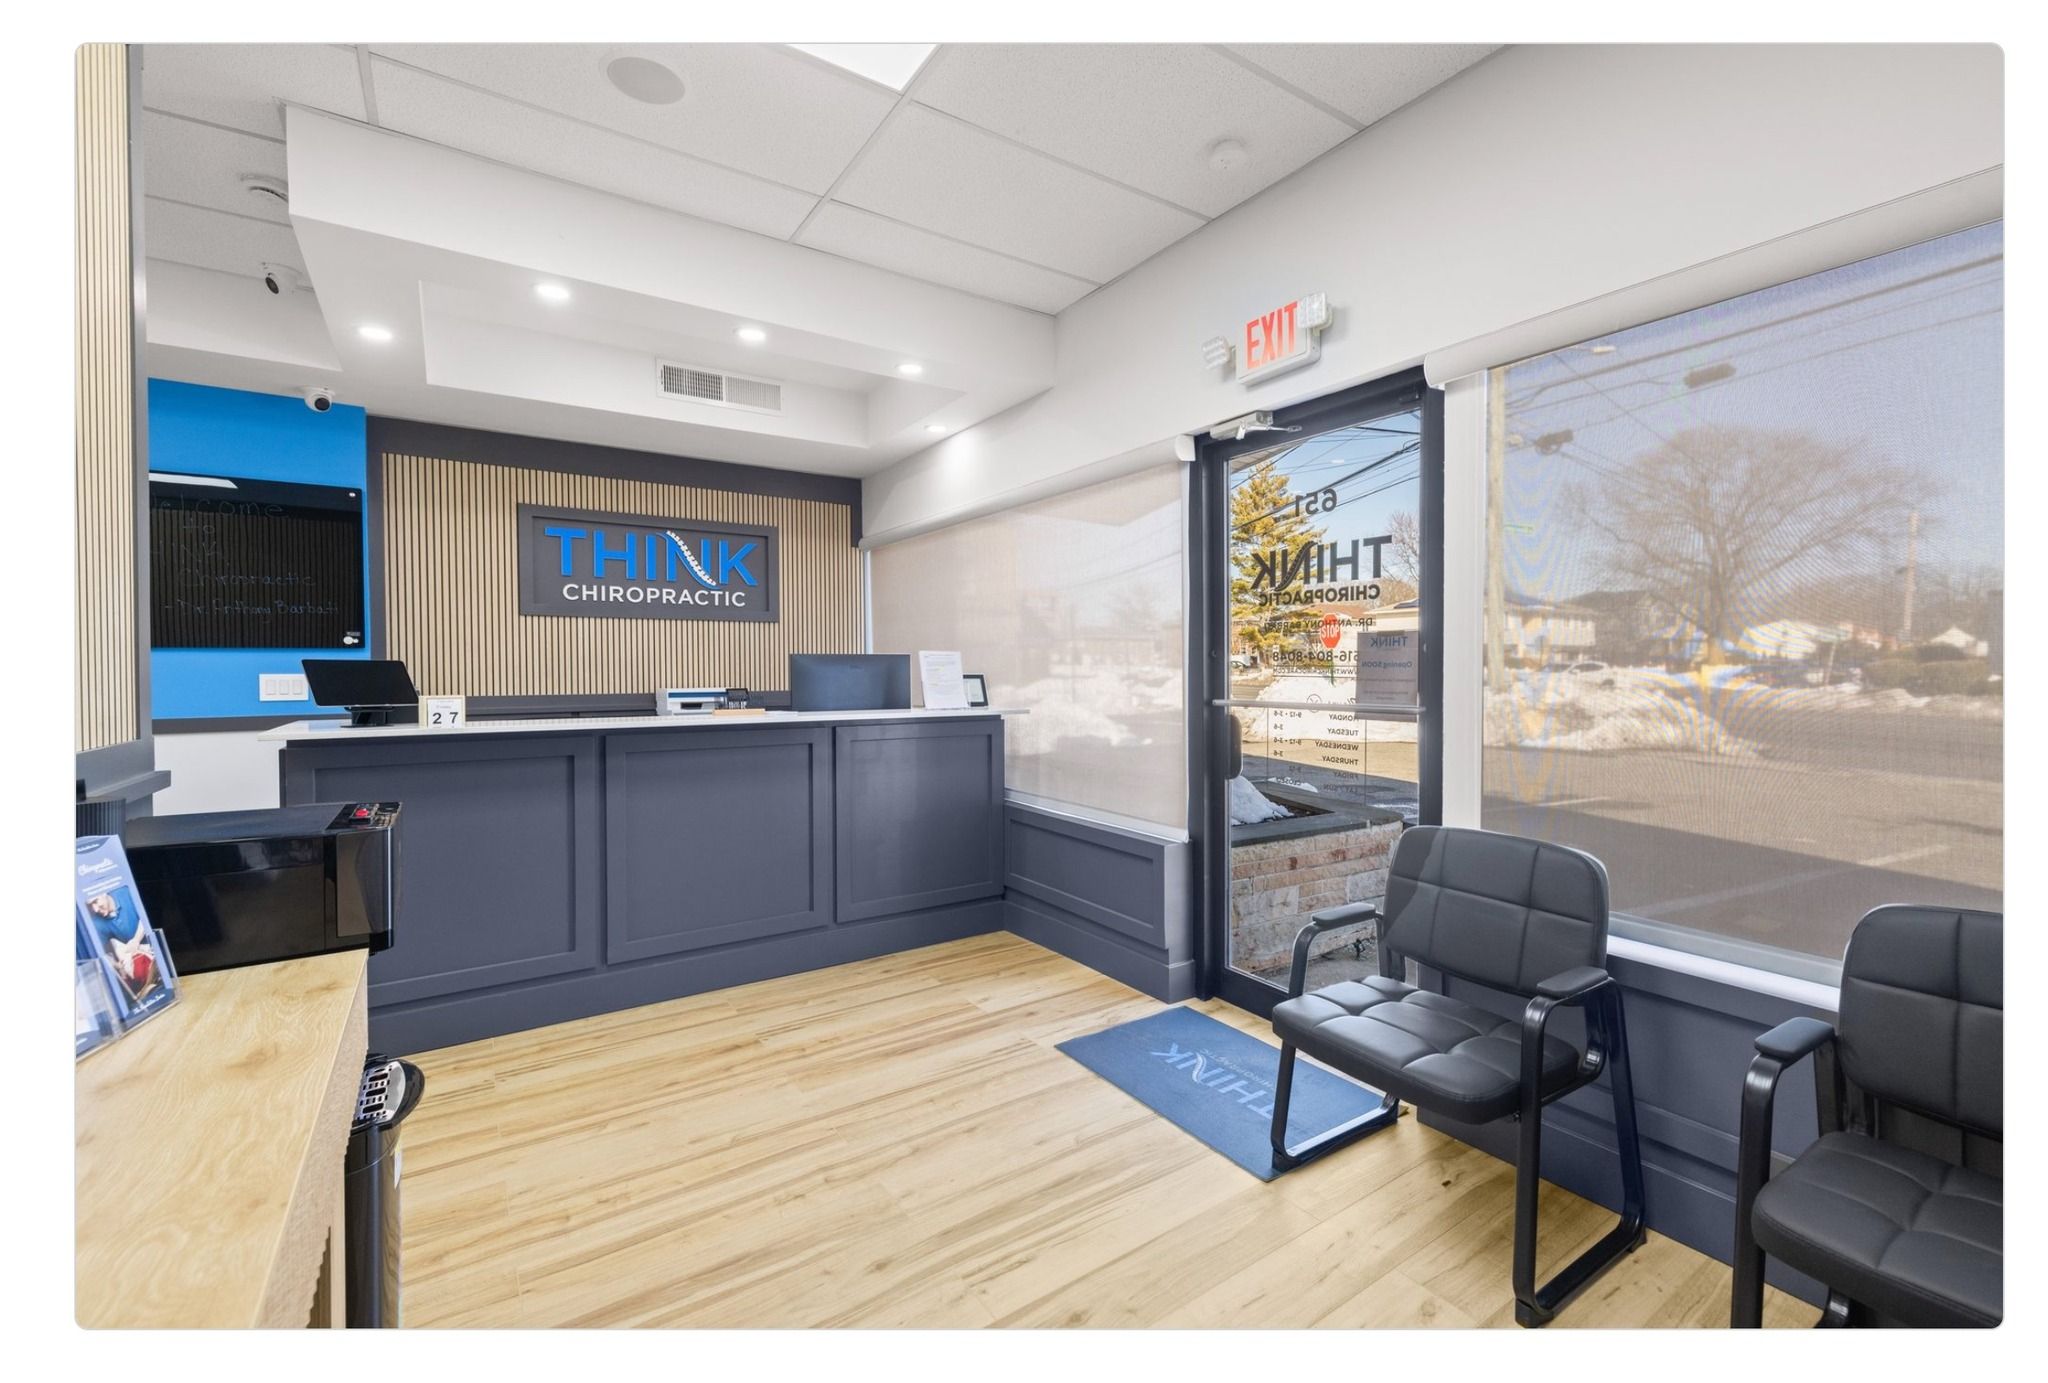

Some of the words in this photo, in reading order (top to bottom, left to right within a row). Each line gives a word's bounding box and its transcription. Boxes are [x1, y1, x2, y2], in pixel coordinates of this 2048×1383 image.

[1247, 301, 1298, 369] EXIT
[150, 492, 288, 517] elcome
[544, 524, 758, 589] THINK
[562, 583, 746, 607] CHIROPRACTIC
[1321, 624, 1340, 639] STOP
